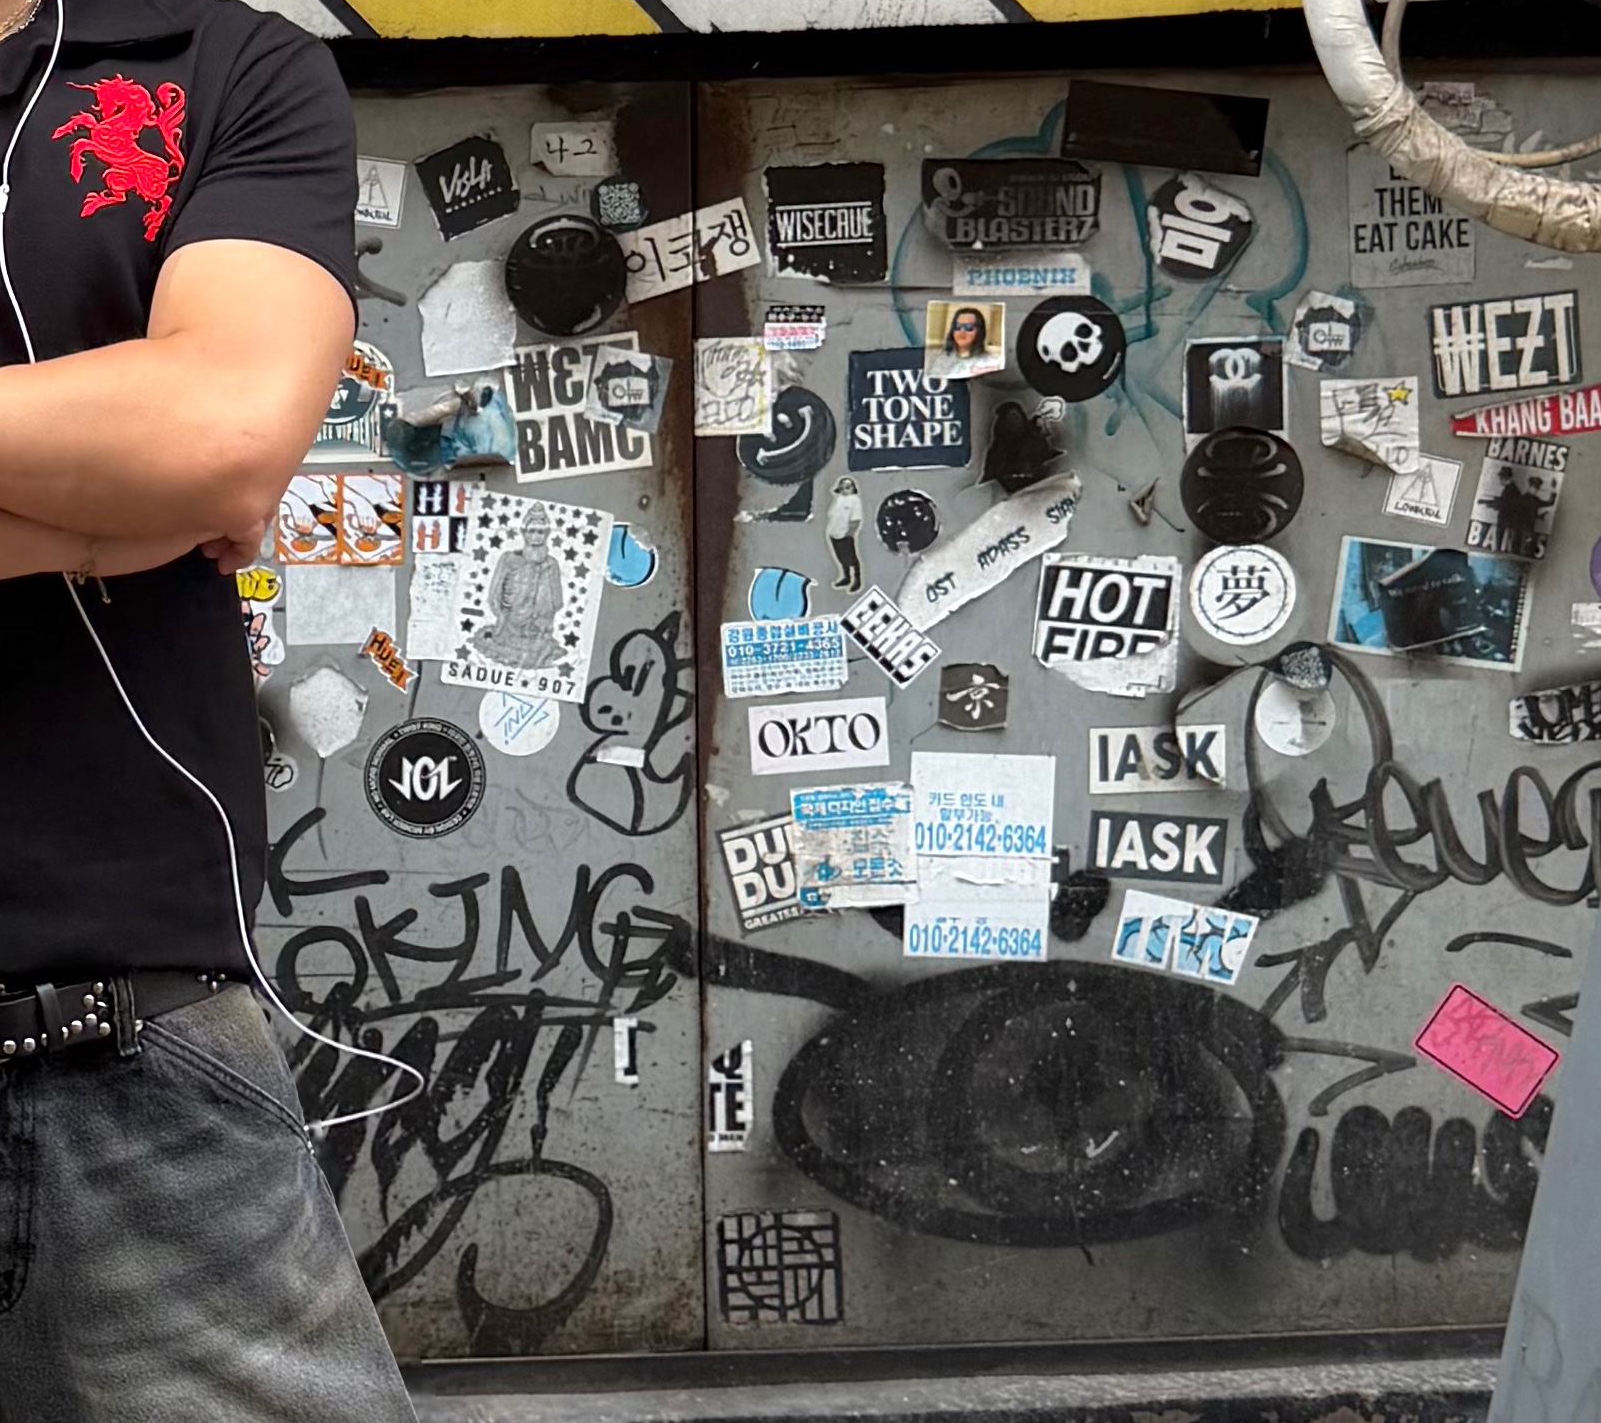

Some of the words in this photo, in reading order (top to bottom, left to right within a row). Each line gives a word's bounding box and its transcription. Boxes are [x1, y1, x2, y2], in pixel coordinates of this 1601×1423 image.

[1374, 186, 1444, 218] THEM
[1354, 223, 1398, 255] EAT
[1405, 218, 1470, 252] CAKE
[866, 368, 949, 396] TWO
[861, 393, 955, 424] TONE
[853, 420, 964, 452] SHAPE
[1488, 438, 1569, 472] BARNES
[1047, 569, 1167, 626] HOT
[1215, 565, 1270, 620] 夢
[447, 662, 516, 687] SADUE
[537, 675, 577, 696] 907
[758, 711, 881, 759] OKTO
[1097, 728, 1220, 783] IASK
[1094, 817, 1221, 875] IASK
